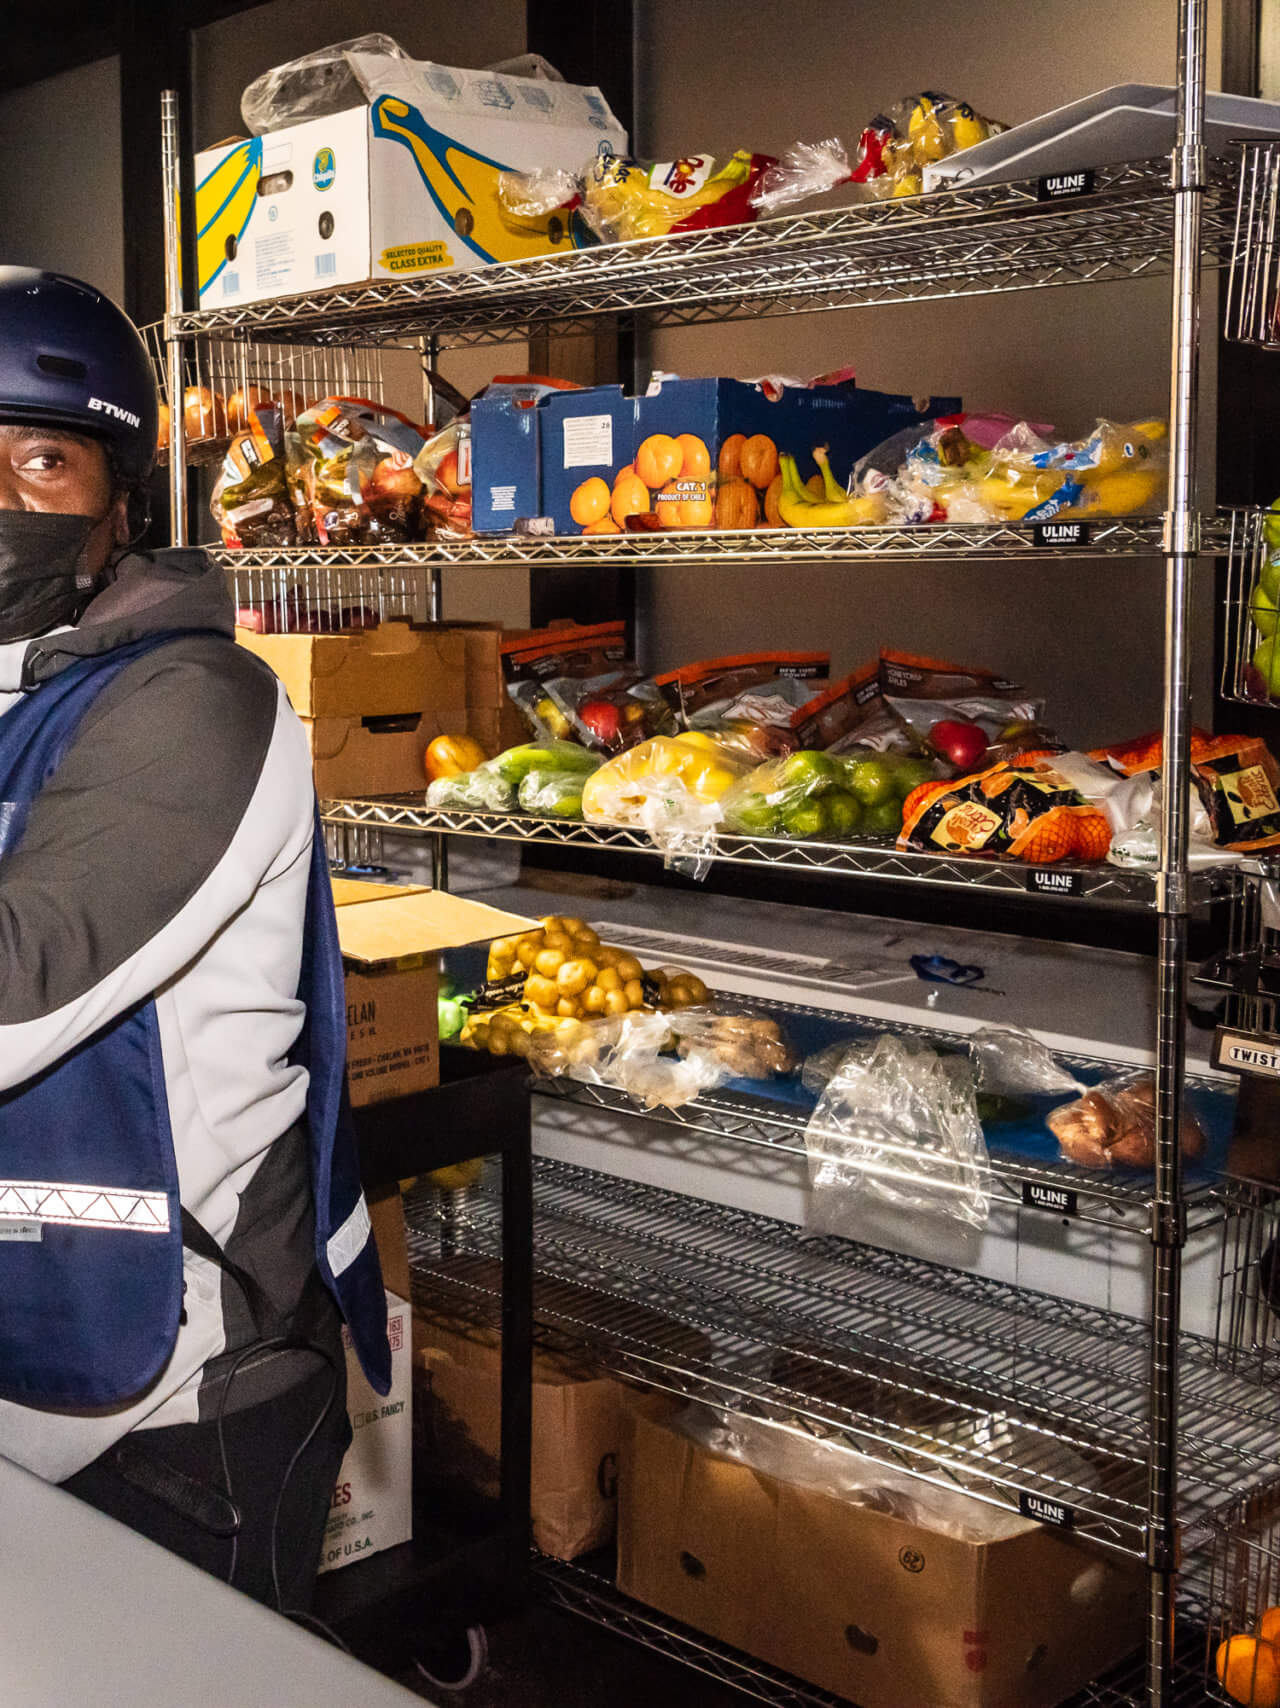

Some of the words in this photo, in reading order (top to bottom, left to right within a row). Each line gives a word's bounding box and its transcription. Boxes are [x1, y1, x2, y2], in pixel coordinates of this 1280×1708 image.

[670, 156, 705, 194] Dole
[1046, 173, 1086, 191] ULINE
[386, 248, 417, 259] SELECTED
[417, 244, 442, 256] QUALITY
[390, 258, 417, 271] CLASS
[417, 254, 444, 267] EXTRA
[87, 396, 141, 429] BTWIN
[676, 482, 698, 491] CAT.
[1041, 524, 1081, 538] ULINE
[1034, 872, 1073, 888] ULINE
[1233, 1047, 1278, 1068] TWIST
[1031, 1186, 1069, 1206] ULINE
[380, 1401, 405, 1419] FANCY
[1027, 1497, 1065, 1521] ULINE
